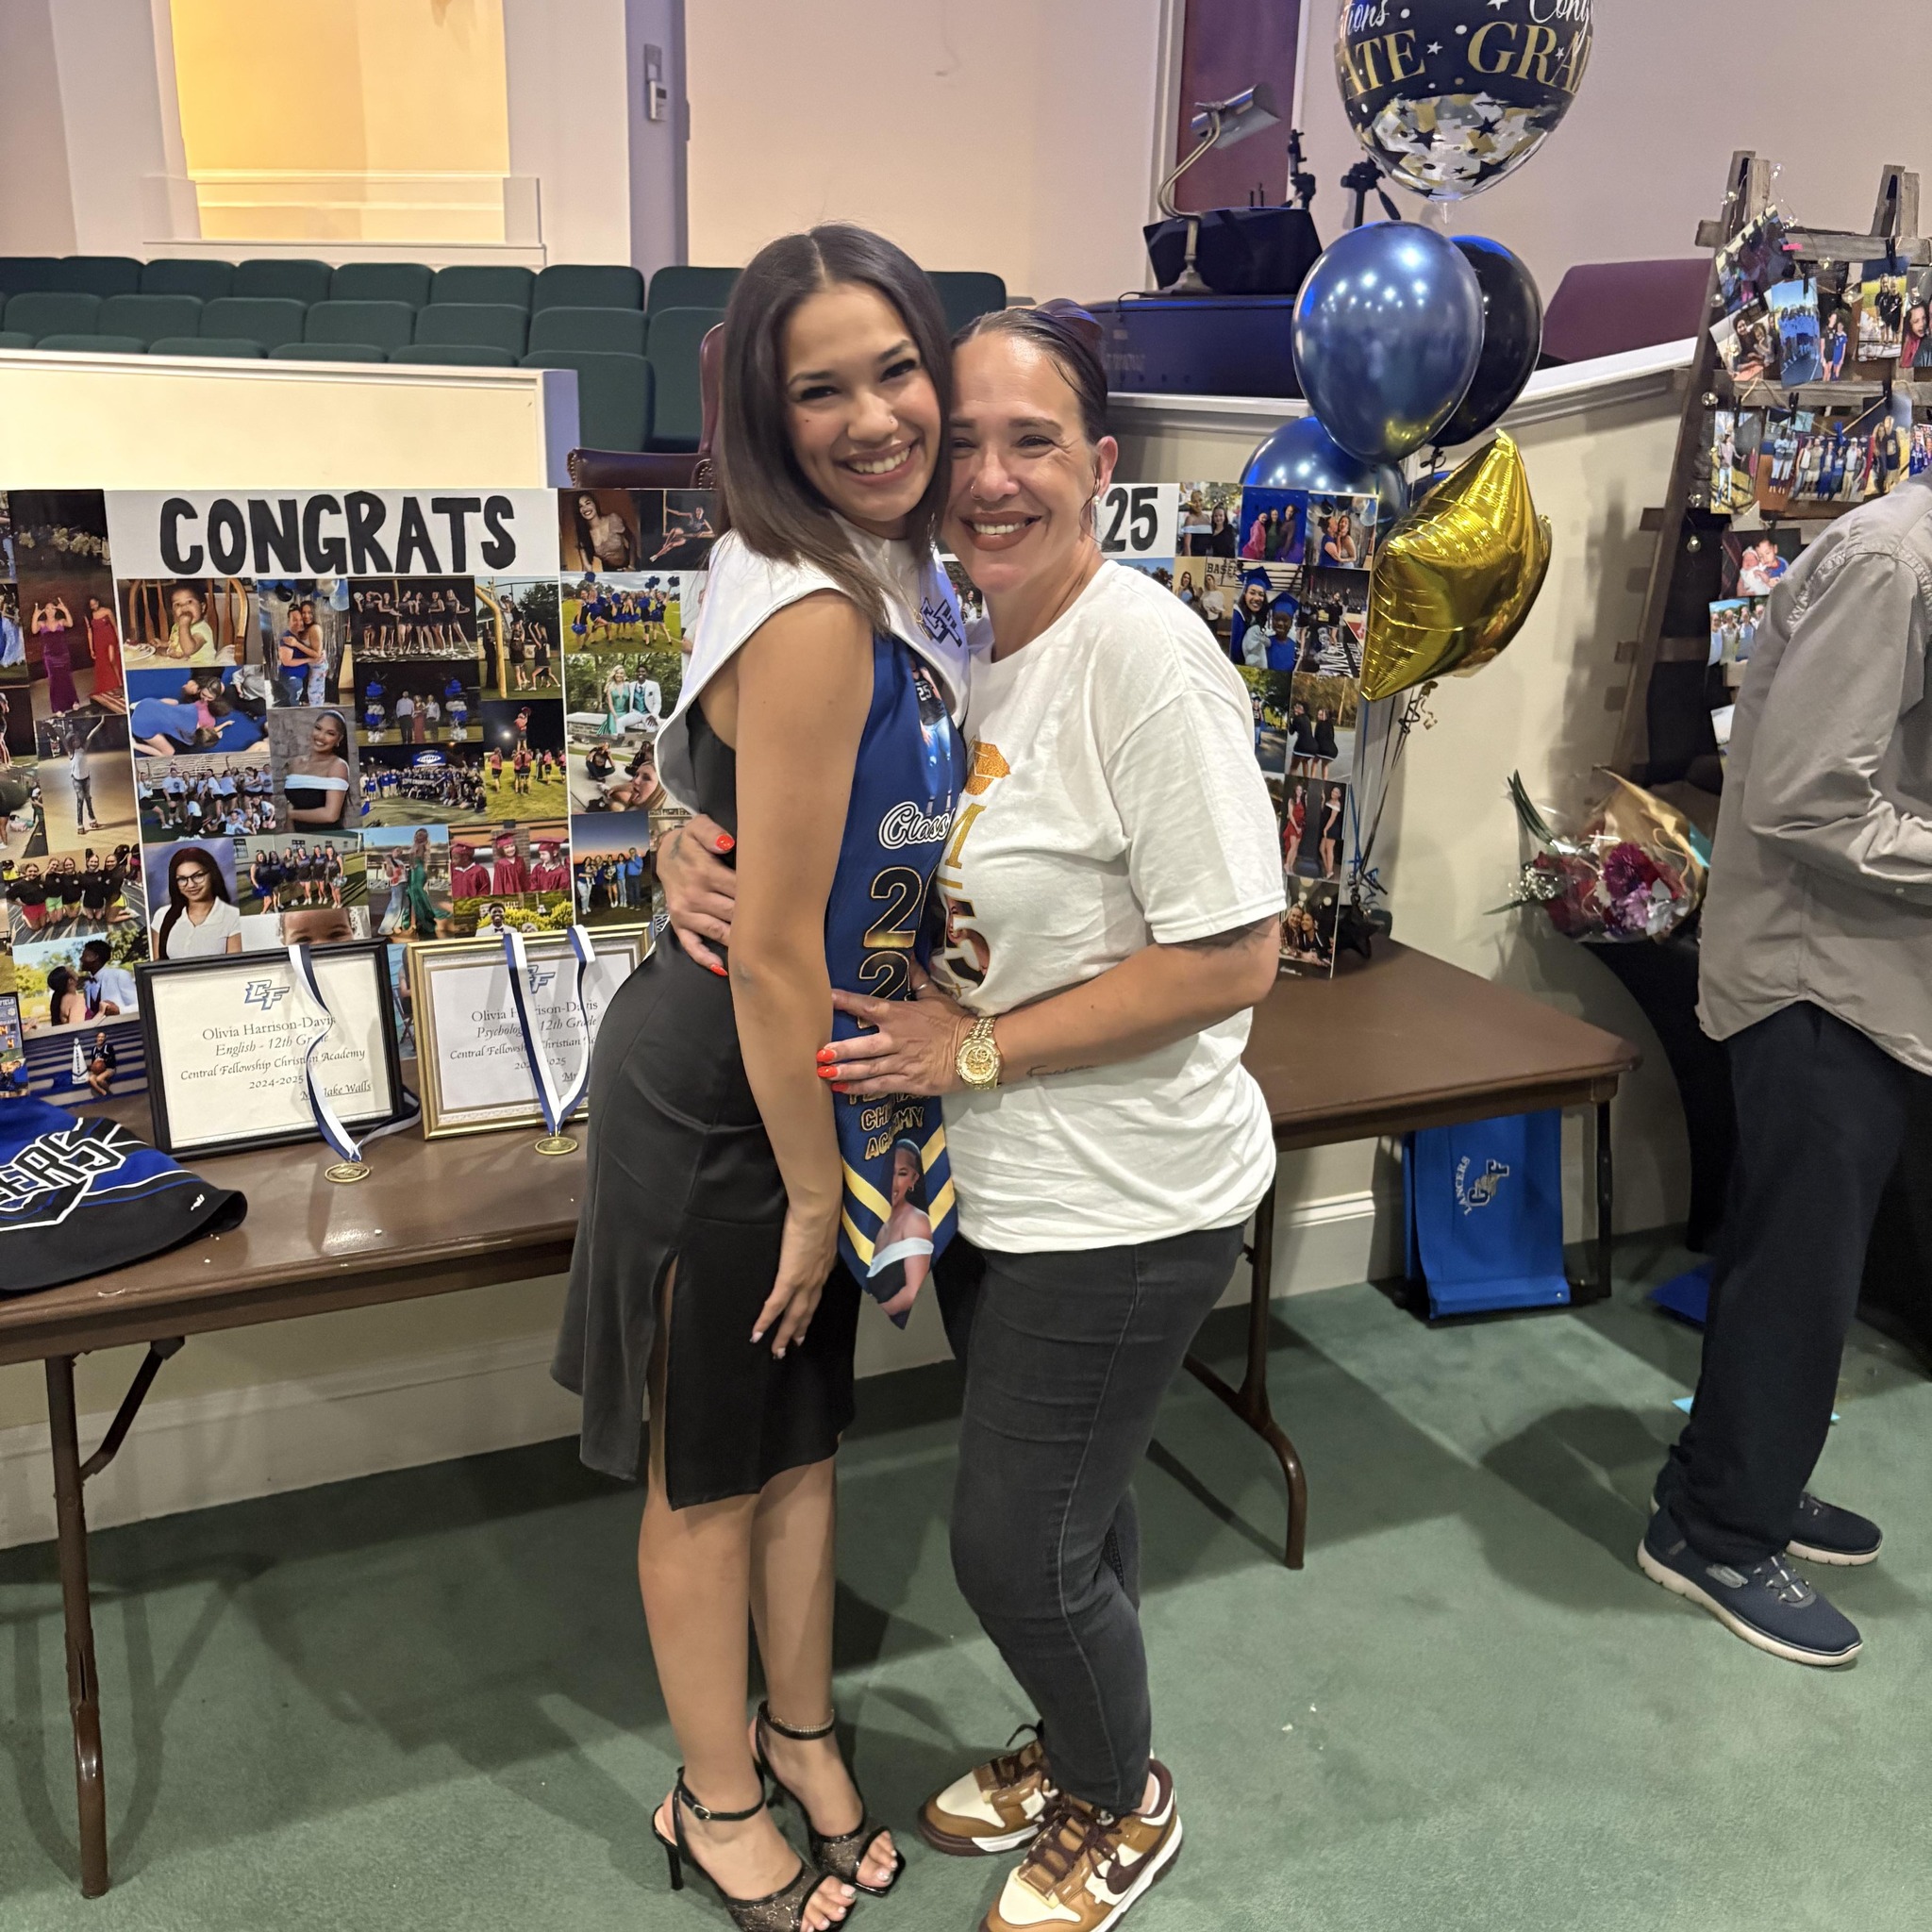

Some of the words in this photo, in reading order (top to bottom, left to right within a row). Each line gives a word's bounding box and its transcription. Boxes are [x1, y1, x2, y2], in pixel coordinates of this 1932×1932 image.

[1468, 21, 1592, 94] GRA
[159, 490, 517, 576] CONGRATS
[878, 801, 949, 850] Class
[202, 1026, 240, 1041] Olivia
[243, 1015, 336, 1036] Harrison-Davis
[471, 1008, 507, 1023] Olivia
[477, 1024, 525, 1041] Psycholog
[541, 1019, 563, 1031] 12th
[216, 1040, 256, 1058] English
[269, 1035, 292, 1049] 12th
[450, 1044, 486, 1059] Central
[487, 1042, 526, 1056] Fellowsh
[541, 1038, 581, 1050] hristian
[180, 1064, 219, 1080] Central
[219, 1058, 272, 1075] Fellowship
[321, 1047, 366, 1062] Academy
[248, 1075, 304, 1090] 2024-2025
[344, 1079, 372, 1094] Walls
[0, 1129, 126, 1211] ERS
[1455, 1155, 1472, 1215] LANCERS
